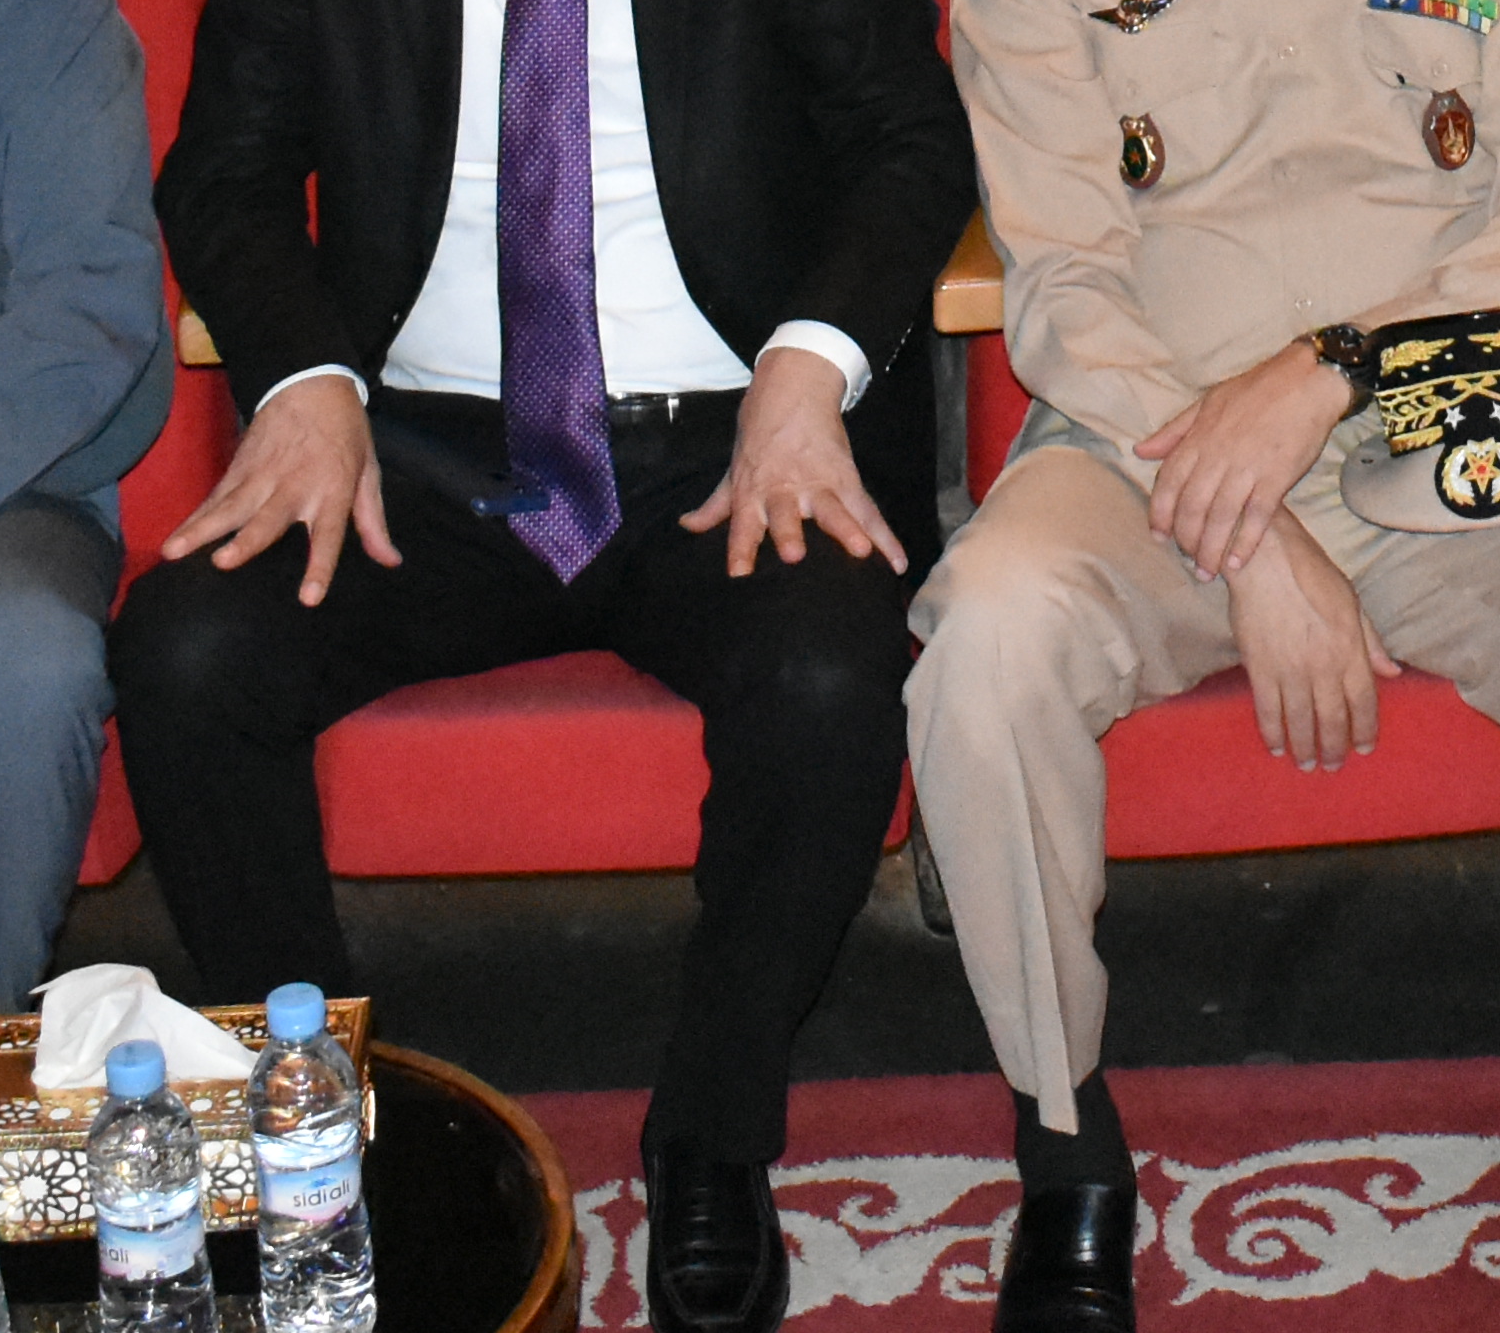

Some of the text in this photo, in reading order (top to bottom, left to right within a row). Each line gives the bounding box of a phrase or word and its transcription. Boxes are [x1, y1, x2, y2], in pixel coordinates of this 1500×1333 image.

[293, 1179, 351, 1208] sidi ali
[111, 1246, 130, 1265] ali
